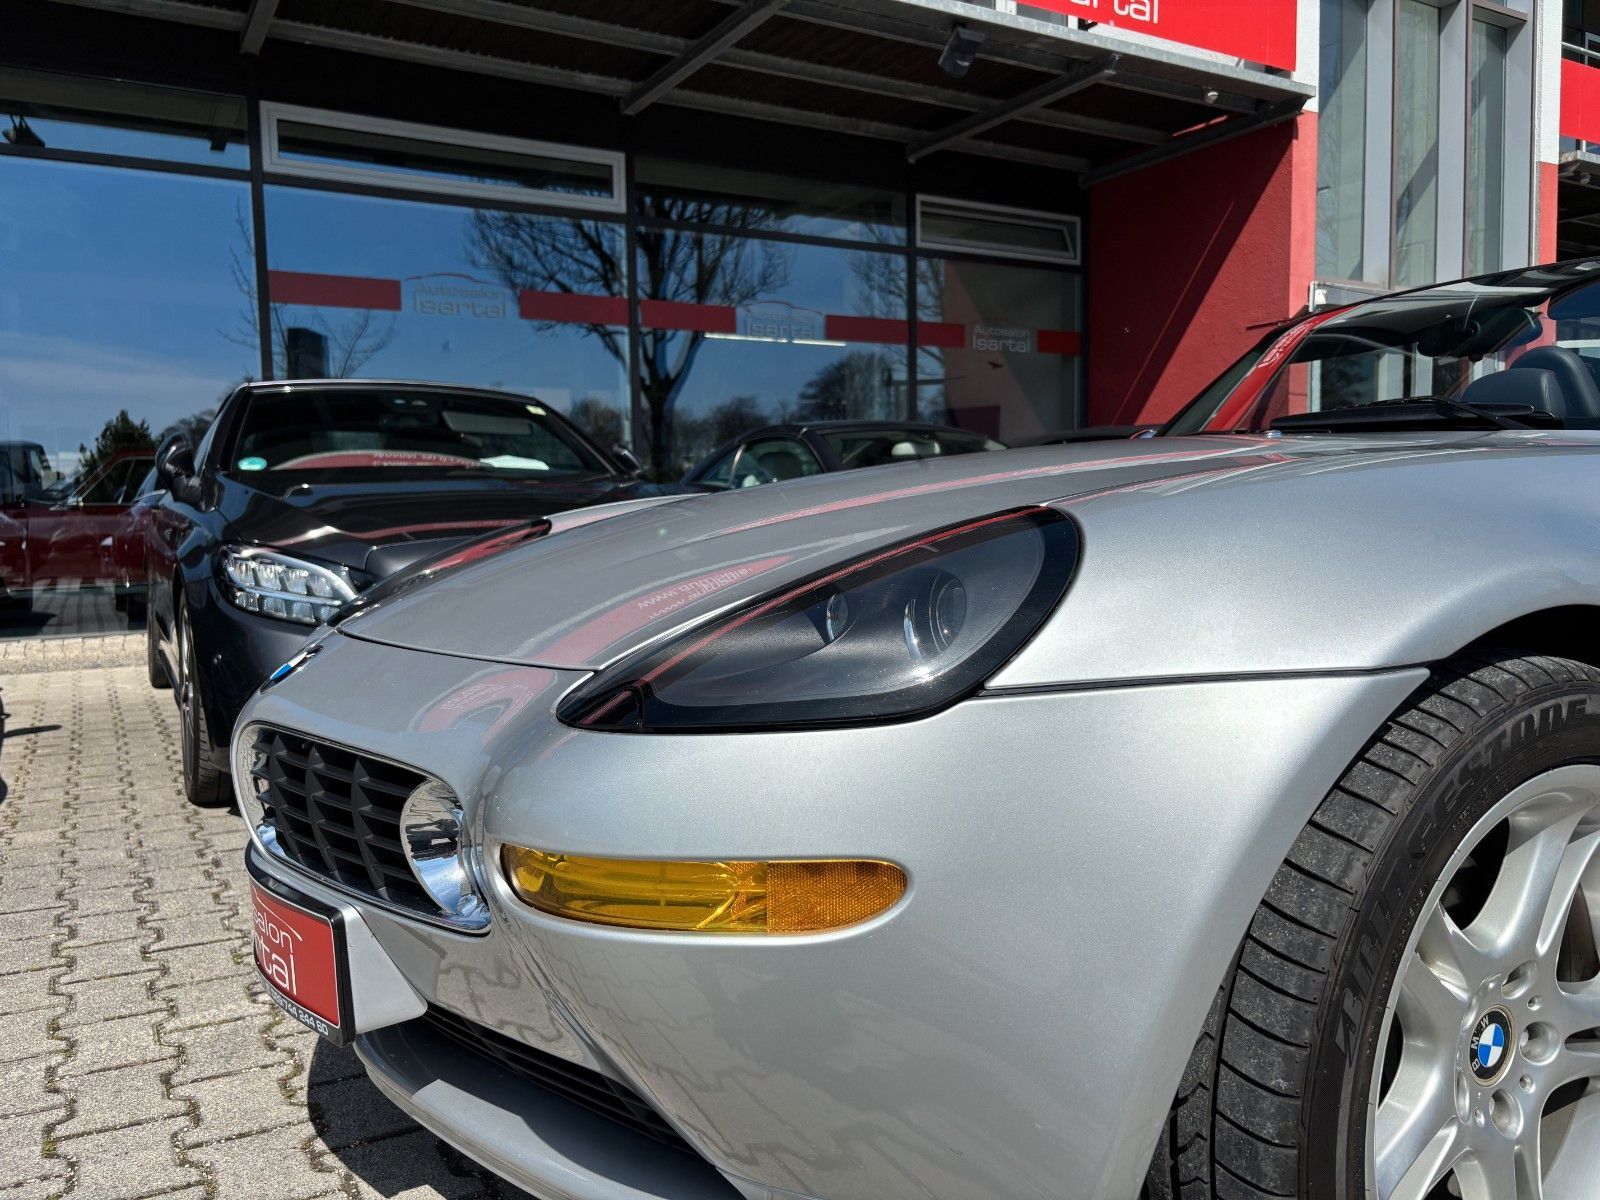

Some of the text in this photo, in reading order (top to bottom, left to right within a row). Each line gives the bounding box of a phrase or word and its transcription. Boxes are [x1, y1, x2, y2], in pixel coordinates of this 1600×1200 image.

[414, 293, 508, 319] Isartal
[974, 325, 1030, 338] Autosalon
[973, 335, 1031, 353] Isartal
